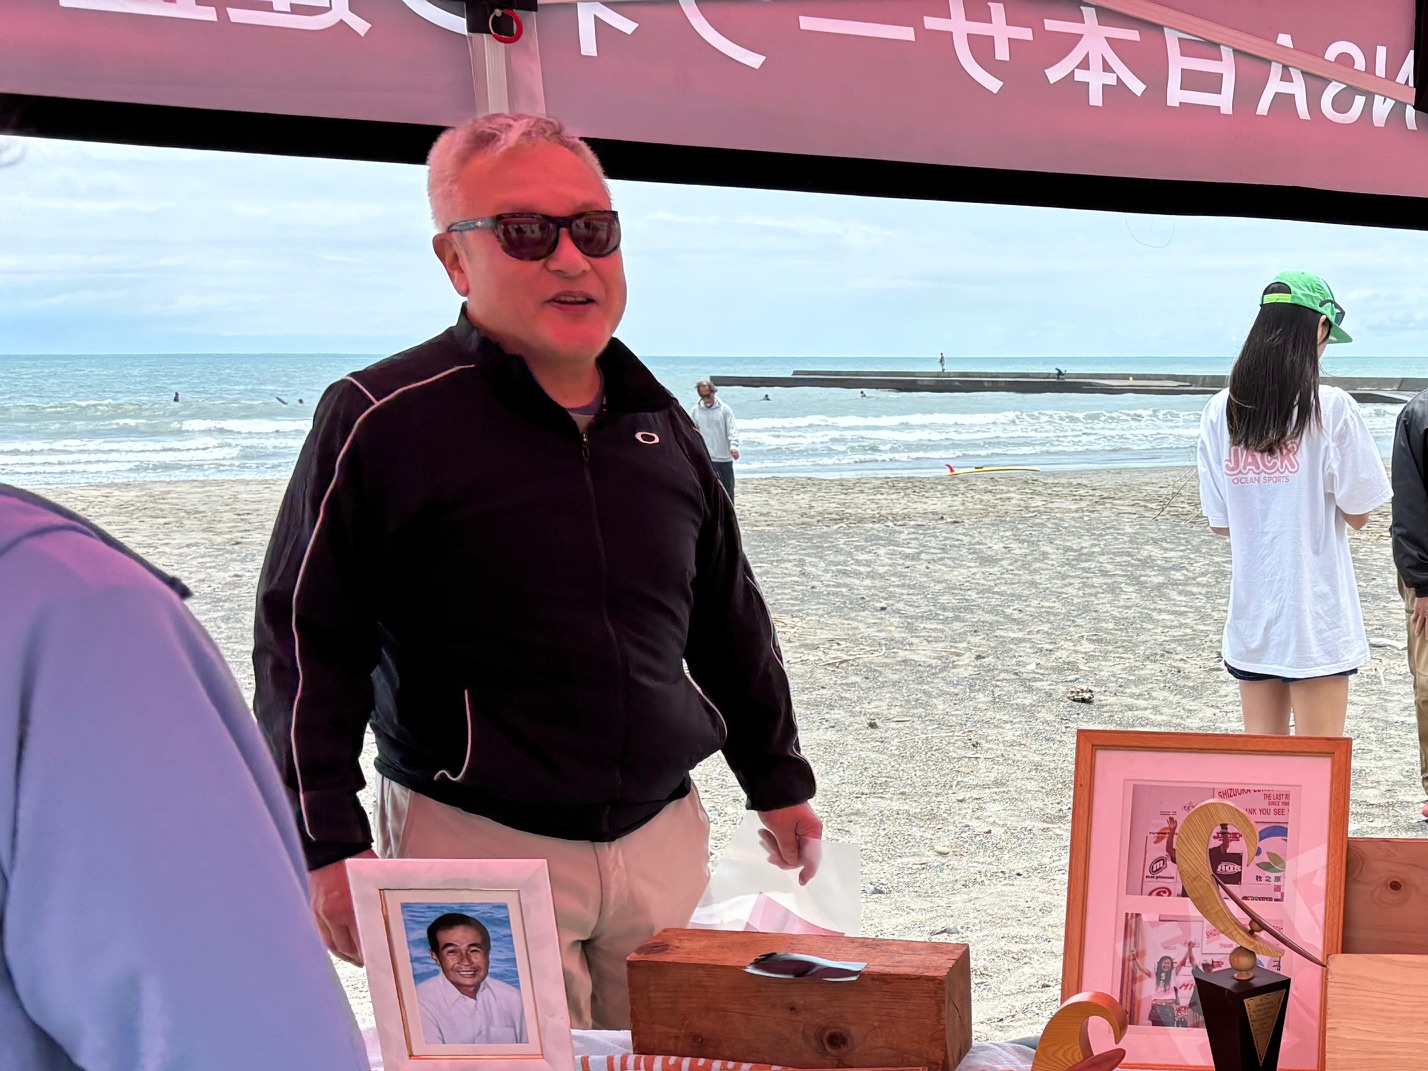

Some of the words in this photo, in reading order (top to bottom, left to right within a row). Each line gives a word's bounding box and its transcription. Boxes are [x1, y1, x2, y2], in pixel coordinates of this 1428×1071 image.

[1225, 442, 1299, 476] JACK
[1232, 476, 1260, 485] OCEAN
[1263, 475, 1290, 484] SPORTS
[1259, 808, 1271, 816] YOU
[1273, 808, 1285, 816] SEE
